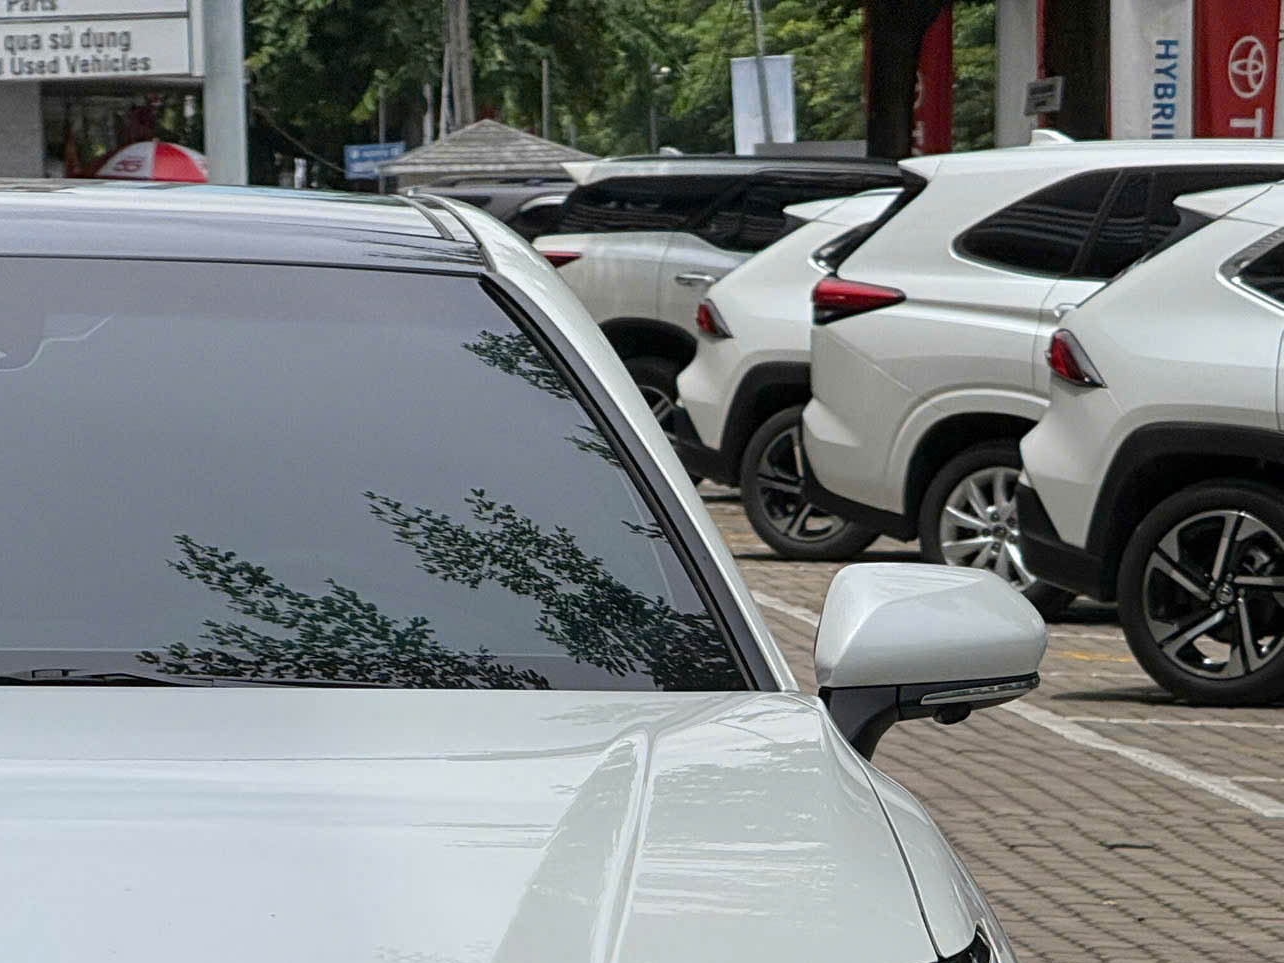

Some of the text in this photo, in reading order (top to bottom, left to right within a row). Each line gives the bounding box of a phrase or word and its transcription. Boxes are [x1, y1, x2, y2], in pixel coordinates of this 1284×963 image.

[4, 33, 42, 55] qua
[80, 27, 131, 53] dụng
[10, 55, 60, 76] Used
[65, 52, 151, 74] Vehicles
